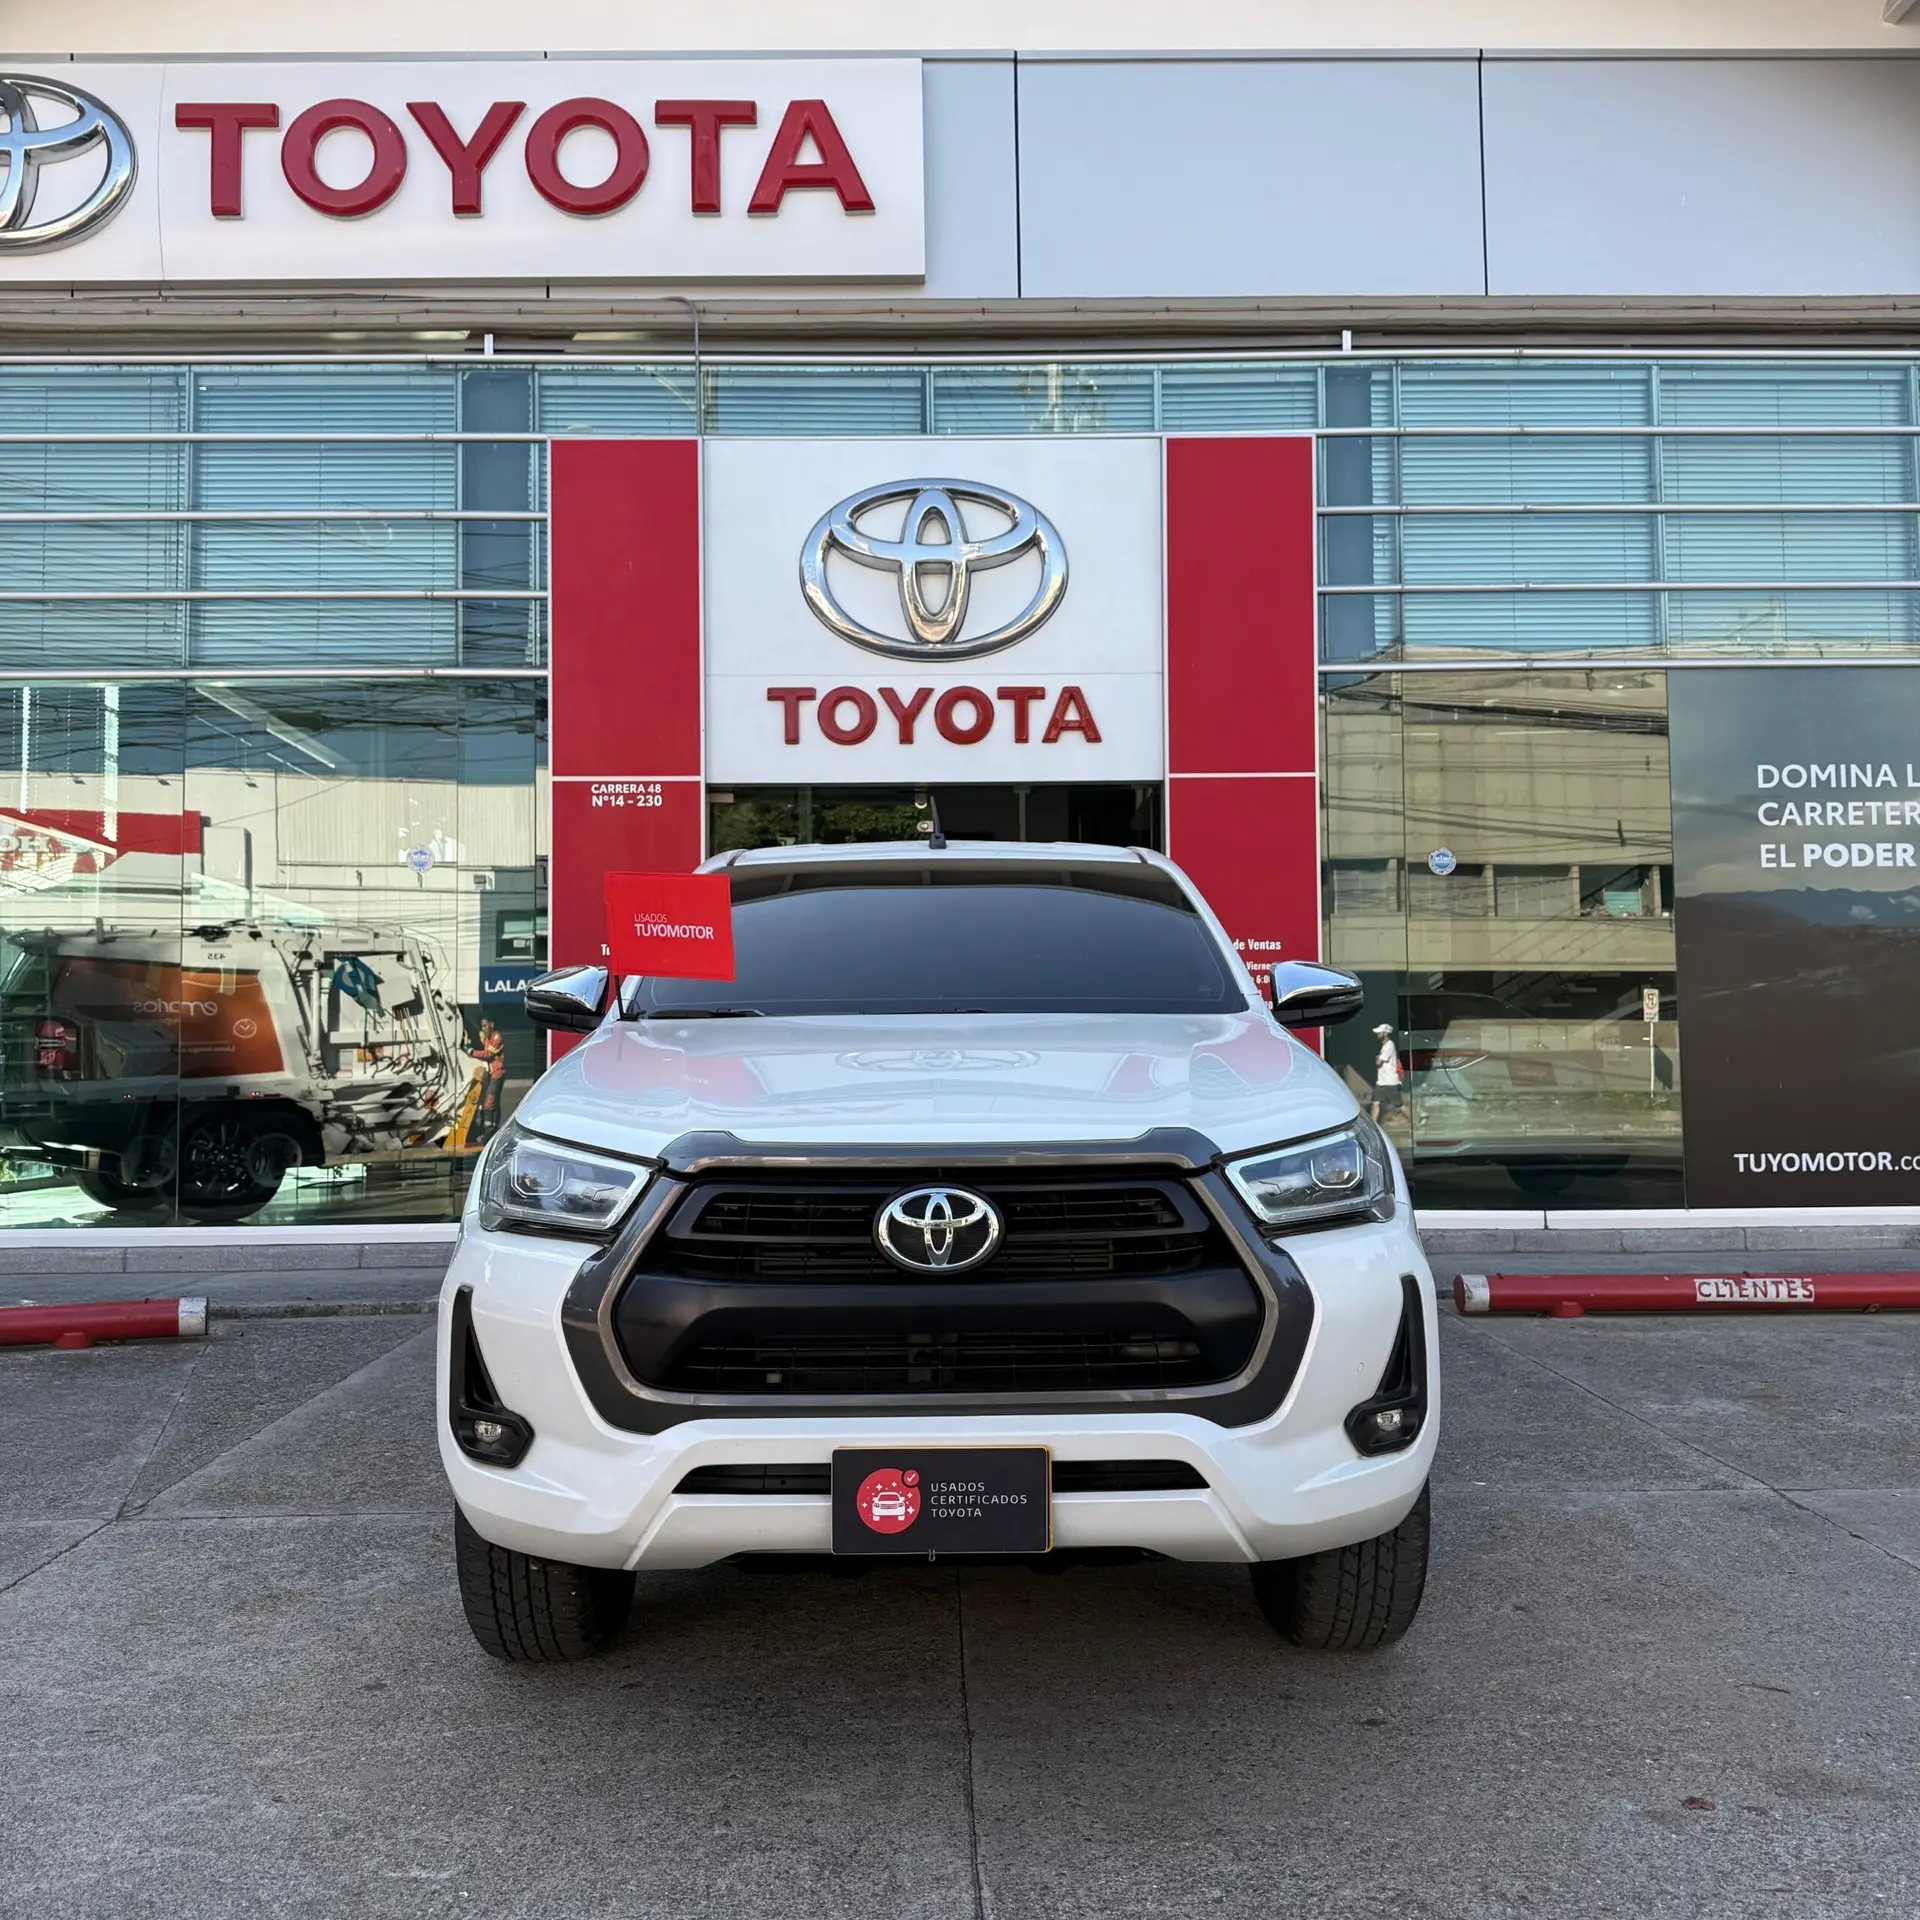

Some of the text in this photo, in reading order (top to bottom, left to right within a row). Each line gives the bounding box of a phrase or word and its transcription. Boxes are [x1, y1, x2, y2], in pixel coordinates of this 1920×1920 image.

[174, 97, 877, 220] TOYOTA
[766, 685, 1103, 746] TOYOTA
[1756, 763, 1898, 789] DOMINA
[591, 784, 662, 794] CARRERA 48
[636, 795, 663, 807] 230
[1757, 801, 1920, 827] CARRETER
[1760, 842, 1917, 868] EL PODER
[634, 913, 668, 924] USADOS
[634, 923, 715, 940] TUYOMOTOR
[1248, 939, 1281, 950] Ventas
[1246, 961, 1271, 970] Vierne
[1697, 1280, 1814, 1299] CLIENTES
[930, 1482, 985, 1492] USADOS
[931, 1495, 1028, 1505] CERTIFICADOS
[931, 1508, 982, 1517] TOYOTA
